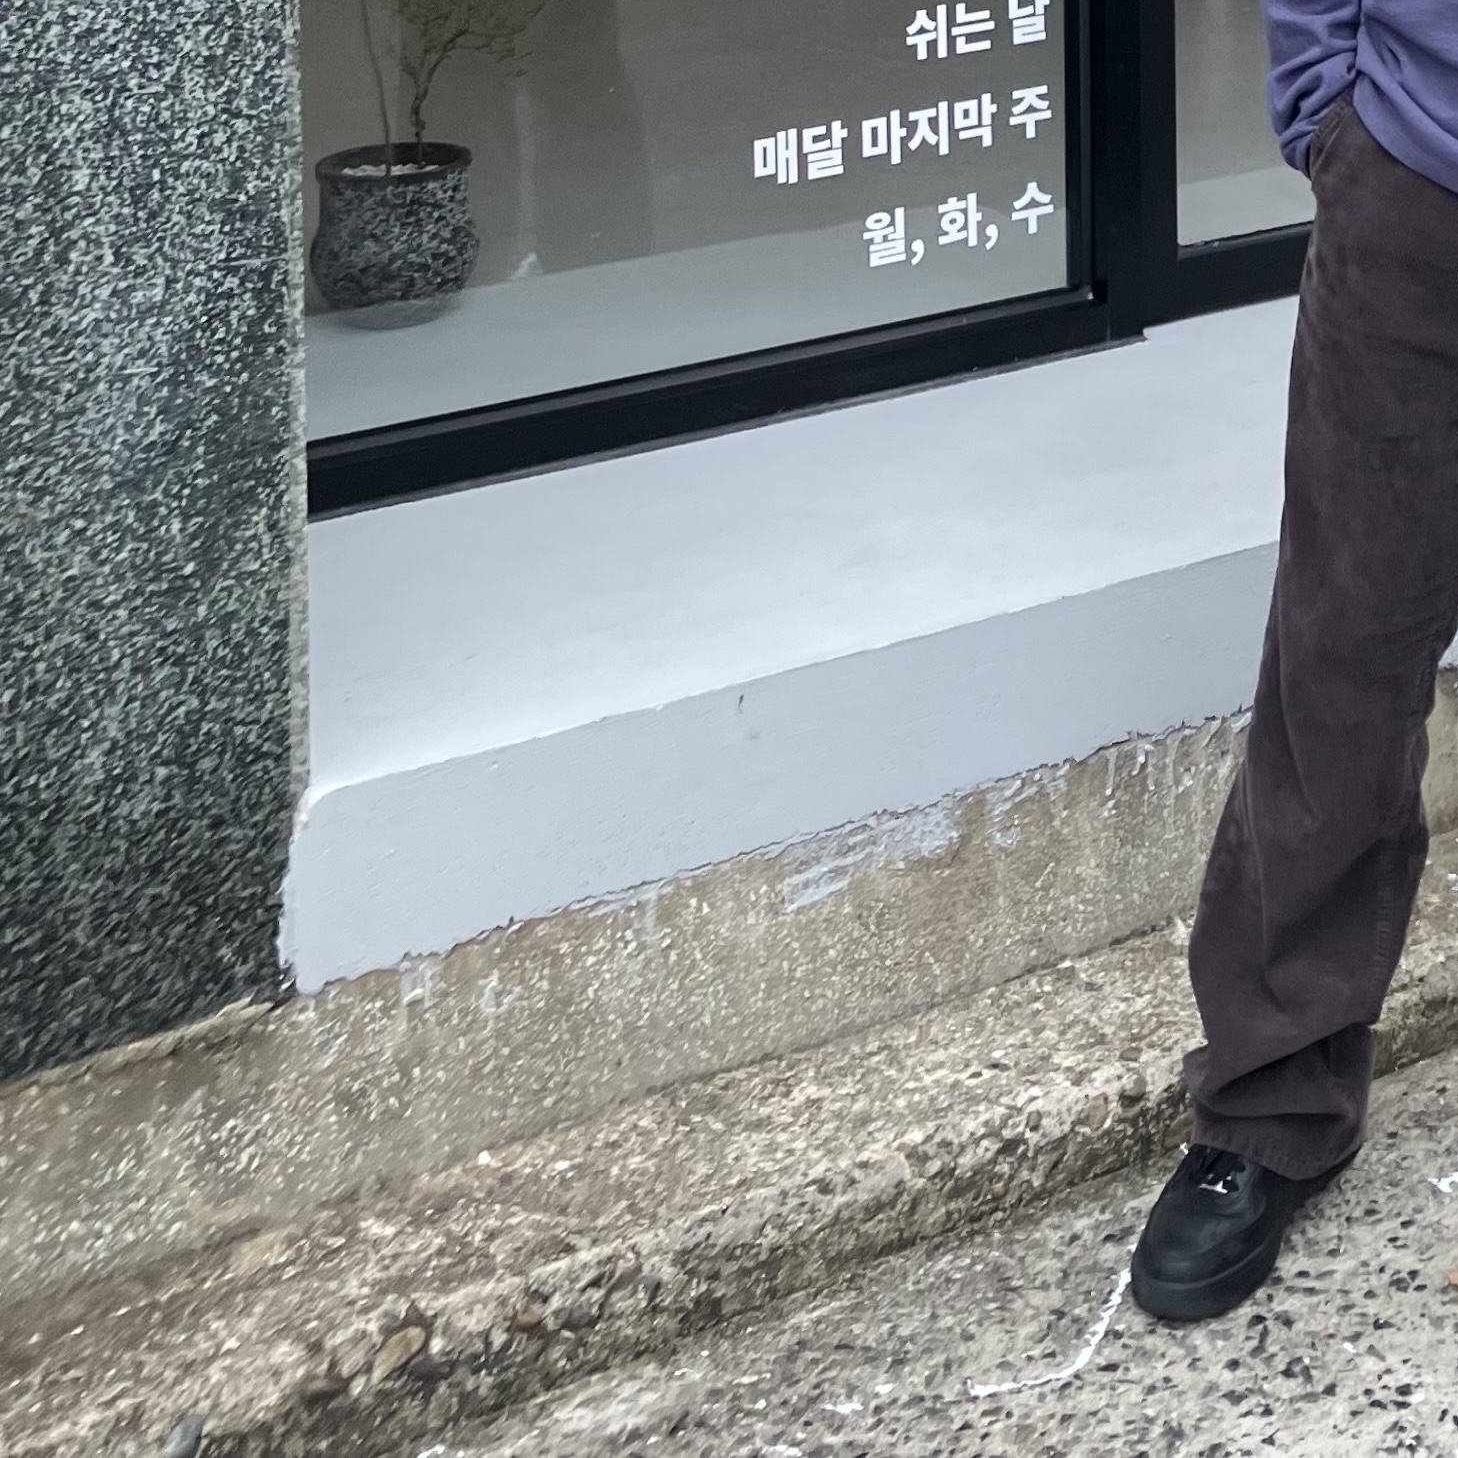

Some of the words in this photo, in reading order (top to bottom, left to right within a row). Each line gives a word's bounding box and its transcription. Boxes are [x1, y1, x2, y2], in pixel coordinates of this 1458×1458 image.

[905, 2, 995, 61] 쉬는
[753, 120, 848, 185] 매달
[861, 92, 998, 165] 마지막
[1009, 84, 1052, 139] 주
[862, 206, 925, 268] 월,
[937, 192, 999, 250] 화,
[1011, 181, 1054, 235] 수
